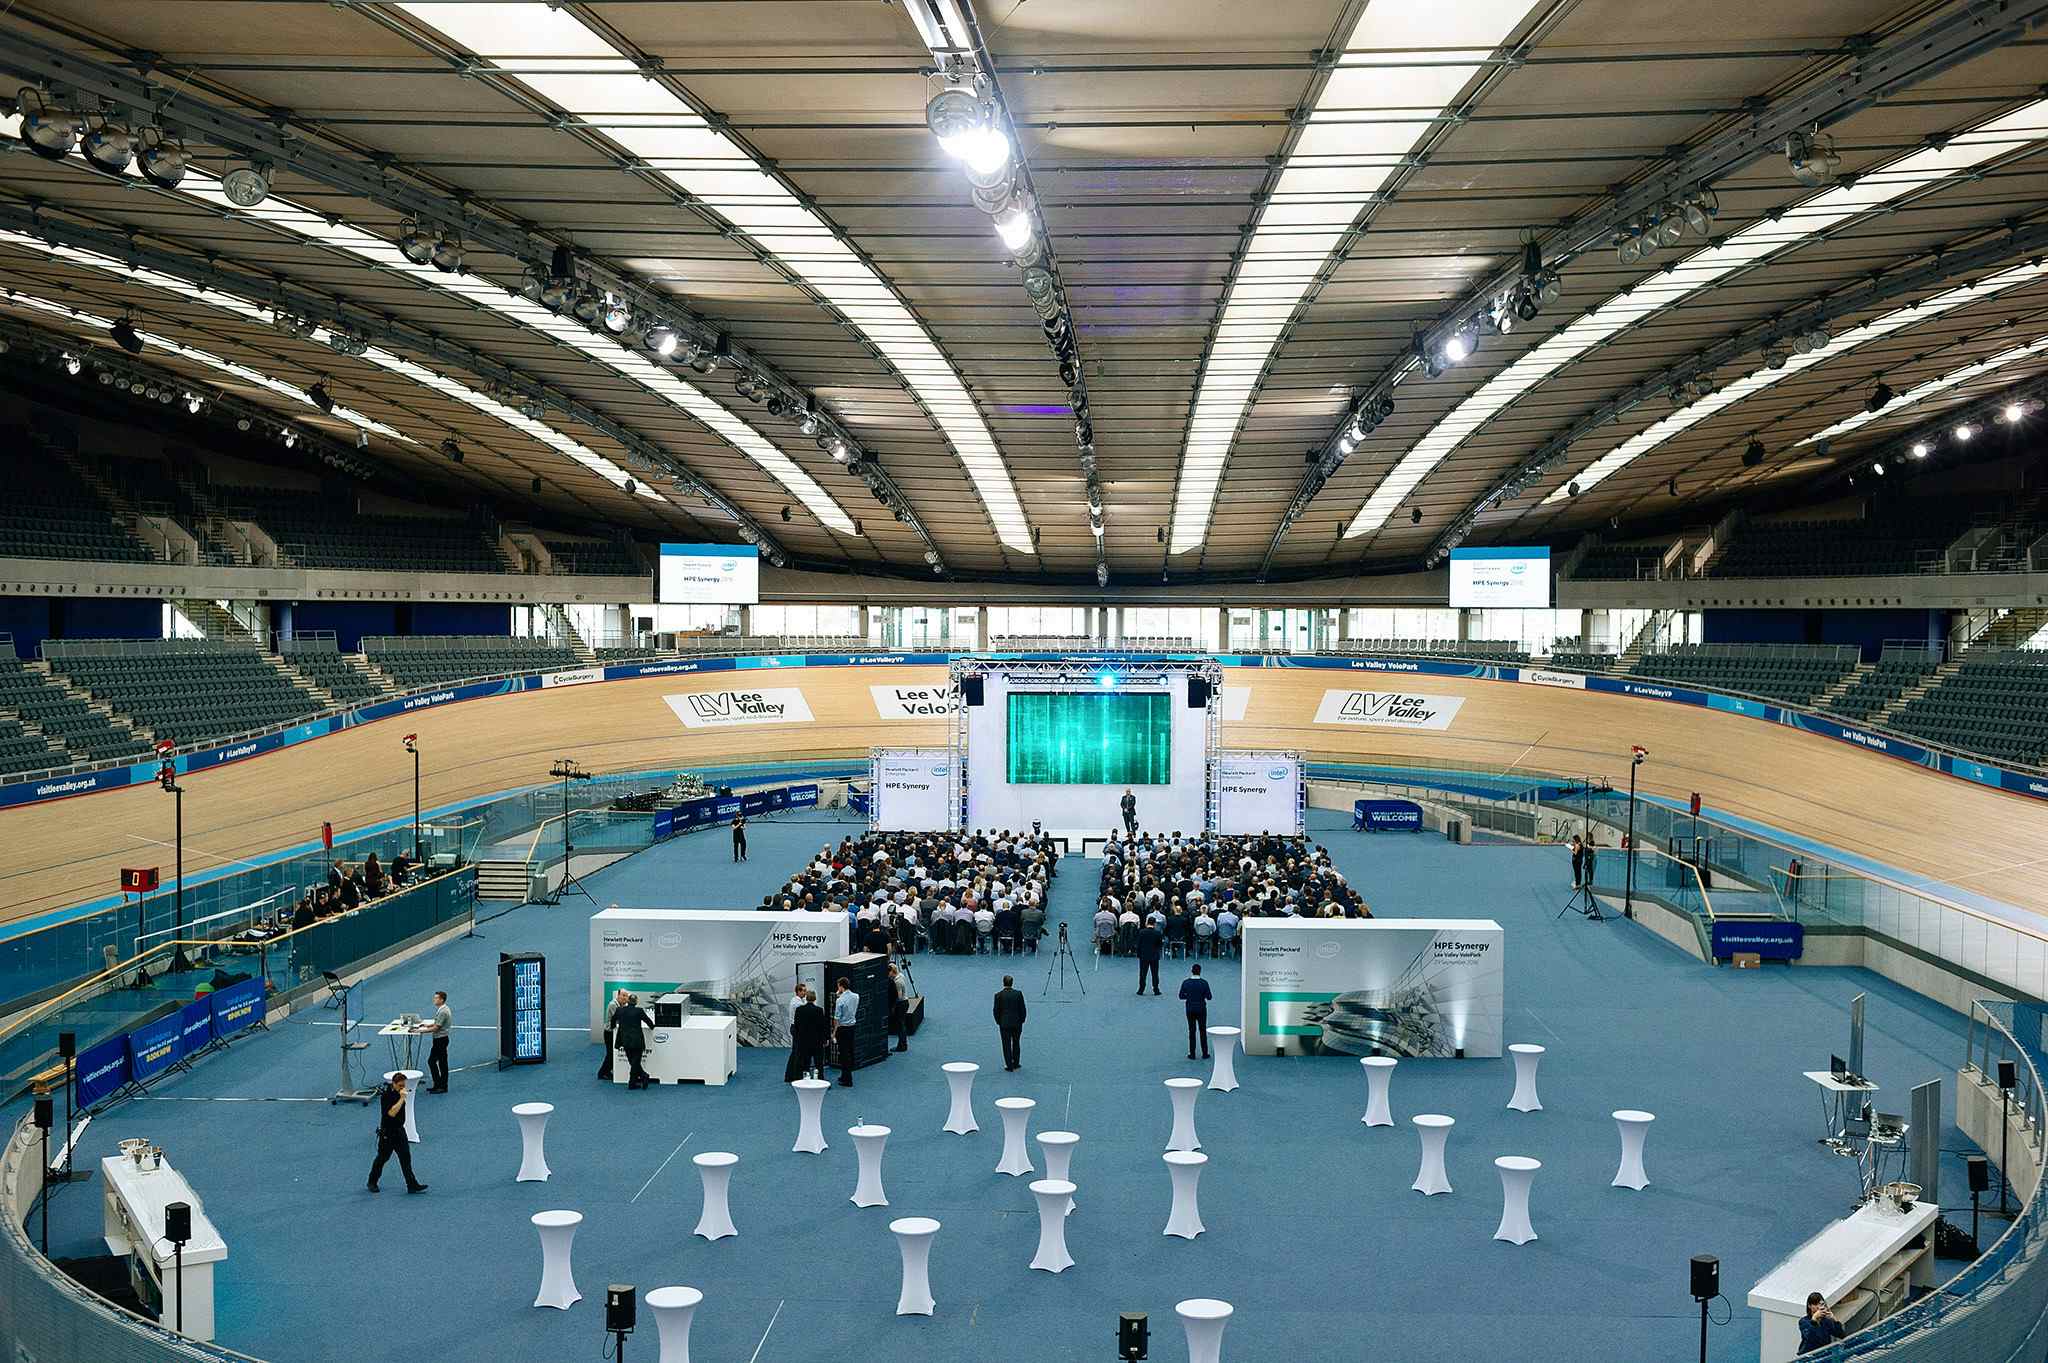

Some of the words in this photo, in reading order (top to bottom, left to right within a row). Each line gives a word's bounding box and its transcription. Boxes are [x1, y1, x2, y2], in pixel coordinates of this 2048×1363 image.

[1351, 660, 1364, 668] Lee
[1366, 661, 1387, 670] Valley
[1388, 662, 1418, 671] VeloPark
[404, 700, 414, 709] Lee
[414, 696, 431, 707] Valley
[431, 691, 455, 704] VeloPark
[731, 692, 763, 703] Lee
[895, 689, 929, 700] Lee
[1391, 694, 1425, 707] Lee
[735, 702, 785, 715] Valley
[1387, 705, 1436, 722] Valley
[1852, 731, 1867, 745] Valley
[1867, 735, 1887, 750] VeloPark
[885, 782, 900, 790] HPE
[902, 782, 930, 791] Synergy
[1238, 786, 1267, 794] Synergy
[773, 933, 791, 941] HPE
[792, 933, 827, 944] Synergy
[1721, 936, 1794, 945] visitleevalley.org.uk
[1434, 942, 1454, 950] HPE
[1454, 942, 1490, 952] Synergy
